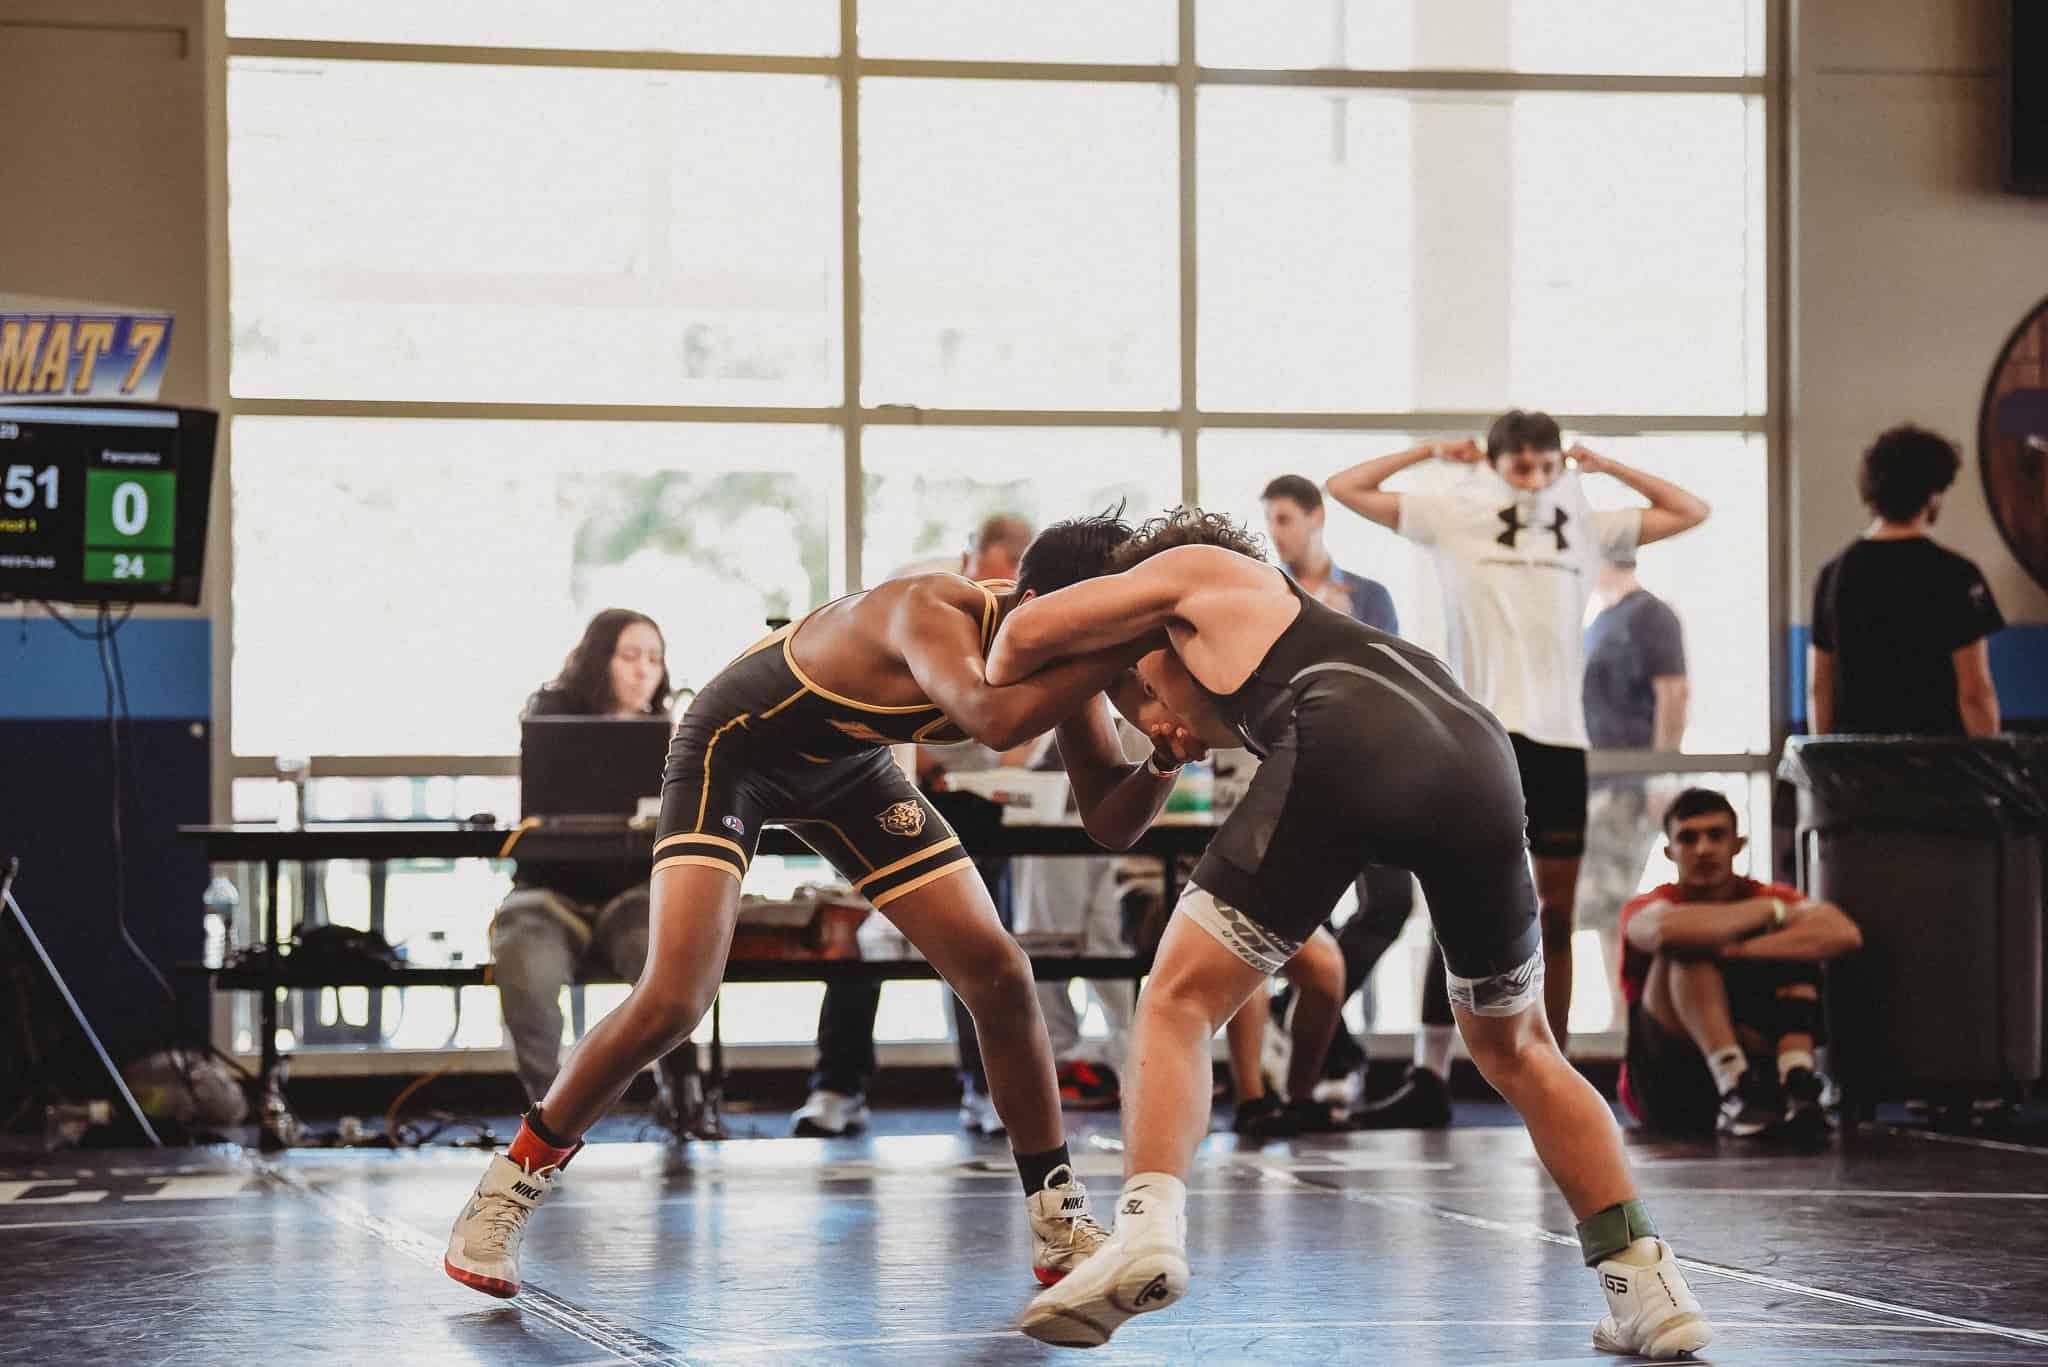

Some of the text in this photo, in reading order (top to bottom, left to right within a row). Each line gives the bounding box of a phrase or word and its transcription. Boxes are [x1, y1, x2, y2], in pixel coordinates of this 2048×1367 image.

[0, 320, 167, 394] MAT 7
[112, 481, 149, 535] 0
[113, 553, 145, 579] 24
